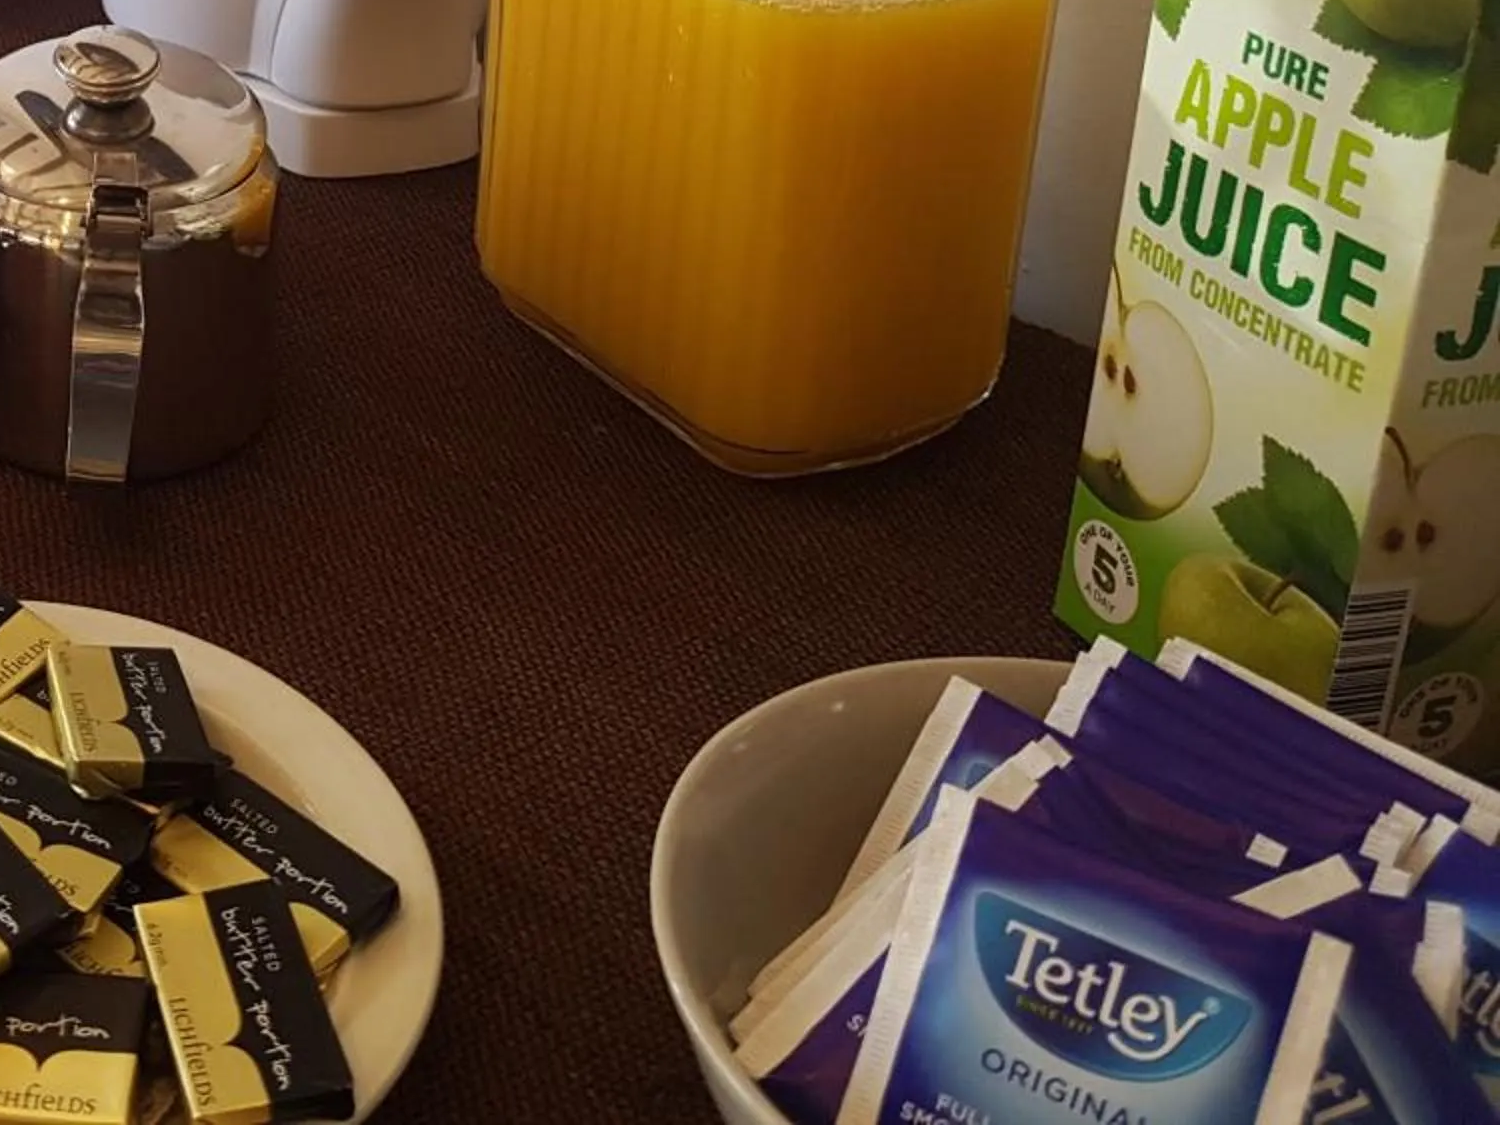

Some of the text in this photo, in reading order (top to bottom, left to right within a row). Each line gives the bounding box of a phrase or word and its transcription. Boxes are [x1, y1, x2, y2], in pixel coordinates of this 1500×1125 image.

[1241, 31, 1331, 101] PURE
[1174, 58, 1375, 220] APPLE
[1138, 139, 1387, 347] JUICE
[1128, 226, 1184, 290] FROM
[1190, 269, 1365, 394] CONCENTRATE
[1091, 543, 1119, 594] 5
[1417, 695, 1458, 736] 5
[26, 803, 112, 850] portion
[229, 798, 278, 835] SALTED
[203, 805, 348, 915] butter portion
[251, 916, 282, 972] SALTED
[221, 906, 292, 1091] butter portion
[1005, 919, 1208, 1062] Tetley
[5, 1014, 111, 1039] portion
